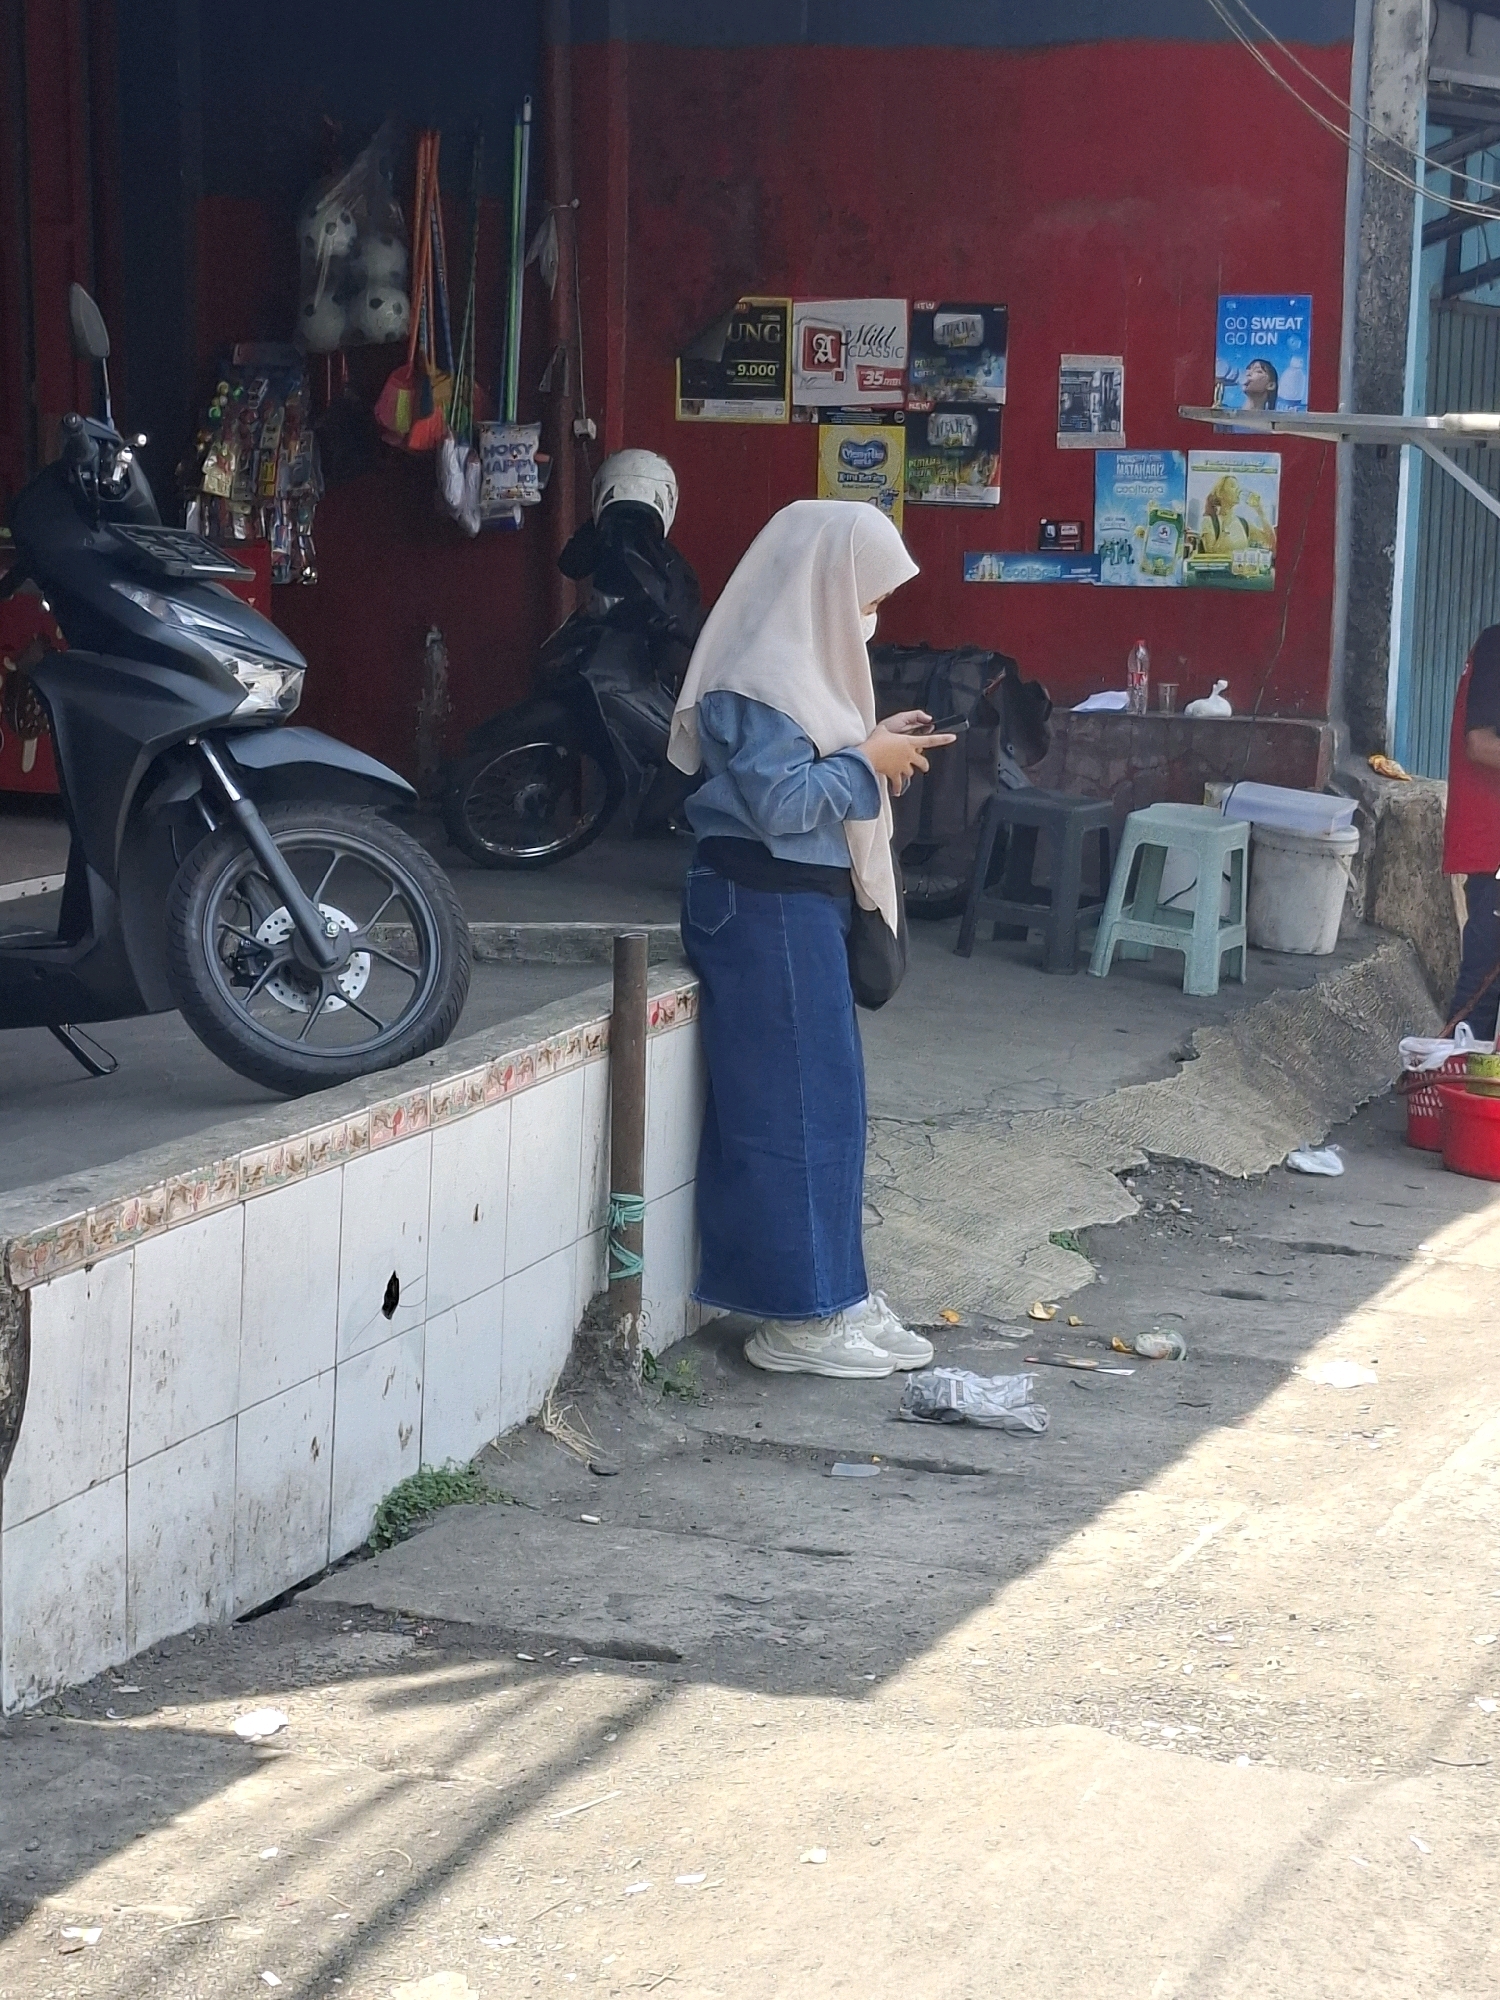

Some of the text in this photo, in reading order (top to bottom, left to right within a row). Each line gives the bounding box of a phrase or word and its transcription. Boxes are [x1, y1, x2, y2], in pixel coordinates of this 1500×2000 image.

[1224, 316, 1304, 330] GO SWEAT
[1224, 331, 1279, 346] GO ION
[847, 345, 905, 359] CLASSIC
